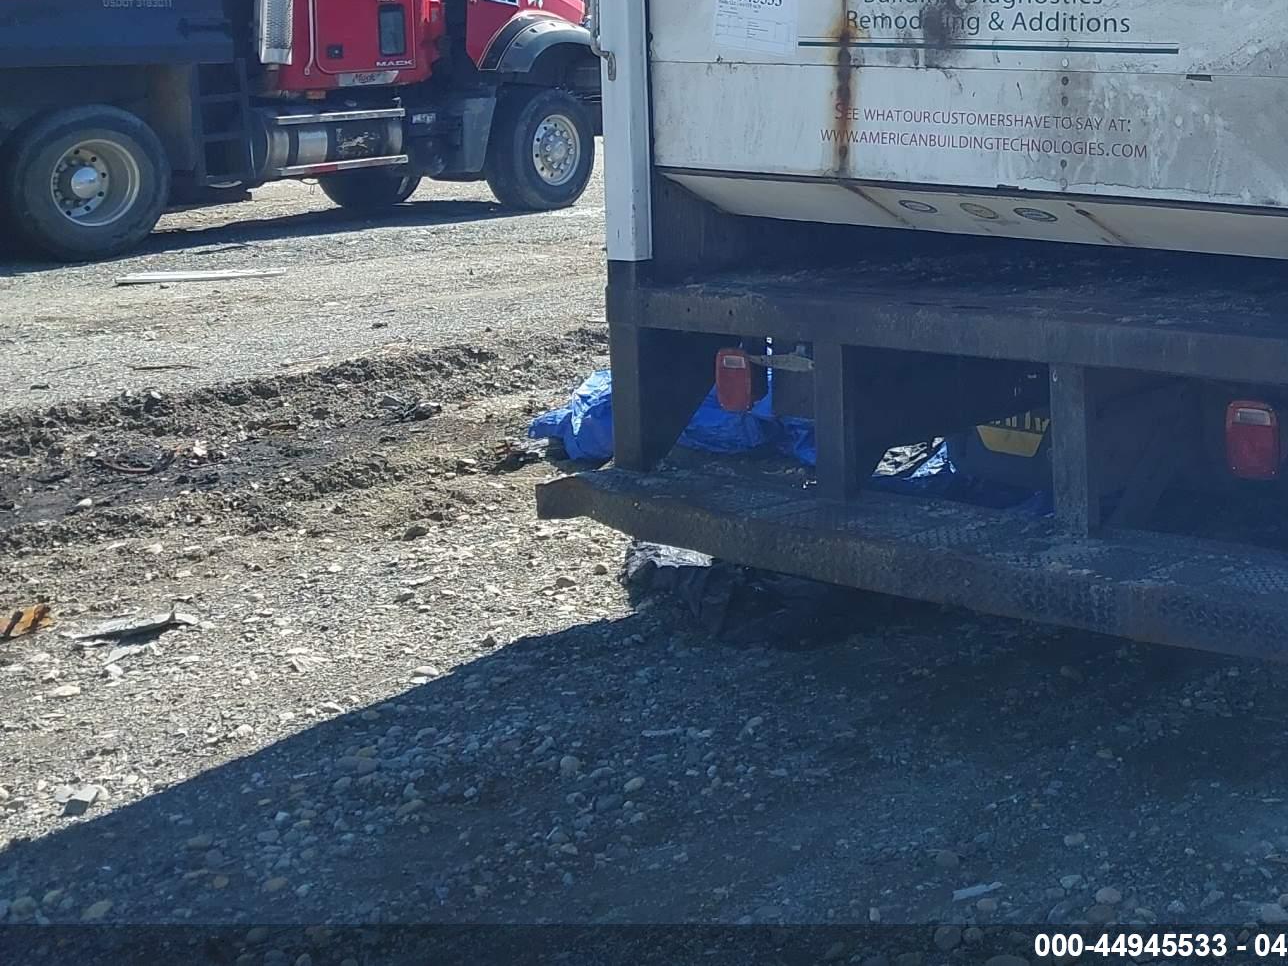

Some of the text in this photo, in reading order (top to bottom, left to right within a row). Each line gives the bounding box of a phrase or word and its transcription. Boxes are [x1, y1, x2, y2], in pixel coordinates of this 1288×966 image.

[988, 13, 1005, 33] &
[1011, 12, 1130, 33] Additions
[1053, 116, 1072, 130] TO
[1076, 117, 1103, 131] SAY
